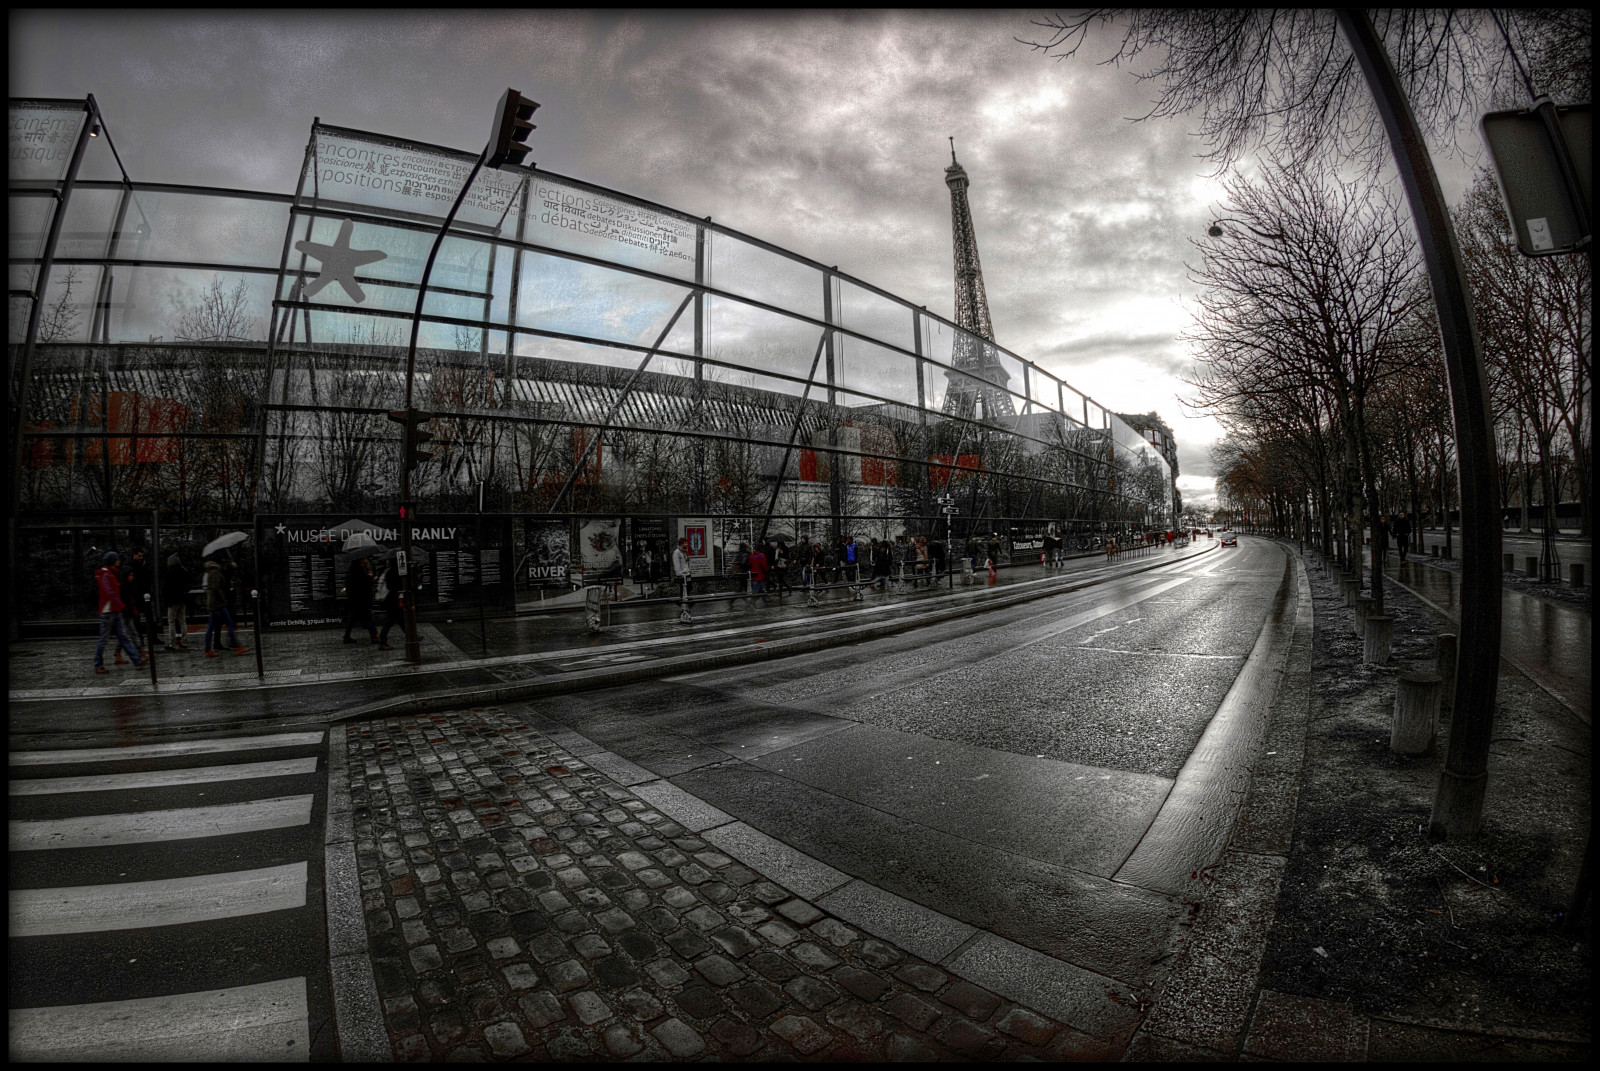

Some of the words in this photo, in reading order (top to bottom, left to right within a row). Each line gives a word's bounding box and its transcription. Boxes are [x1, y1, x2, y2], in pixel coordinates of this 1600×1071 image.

[390, 168, 437, 183] exposições
[401, 161, 451, 178] encounters
[541, 210, 590, 234] débats
[587, 212, 615, 226] debates
[616, 220, 663, 239] Diskussionen
[618, 235, 648, 249] Debates
[288, 526, 337, 543] MUSÉE
[364, 528, 398, 541] QUAI
[411, 527, 457, 541] RANLY
[529, 565, 566, 578] RIVER
